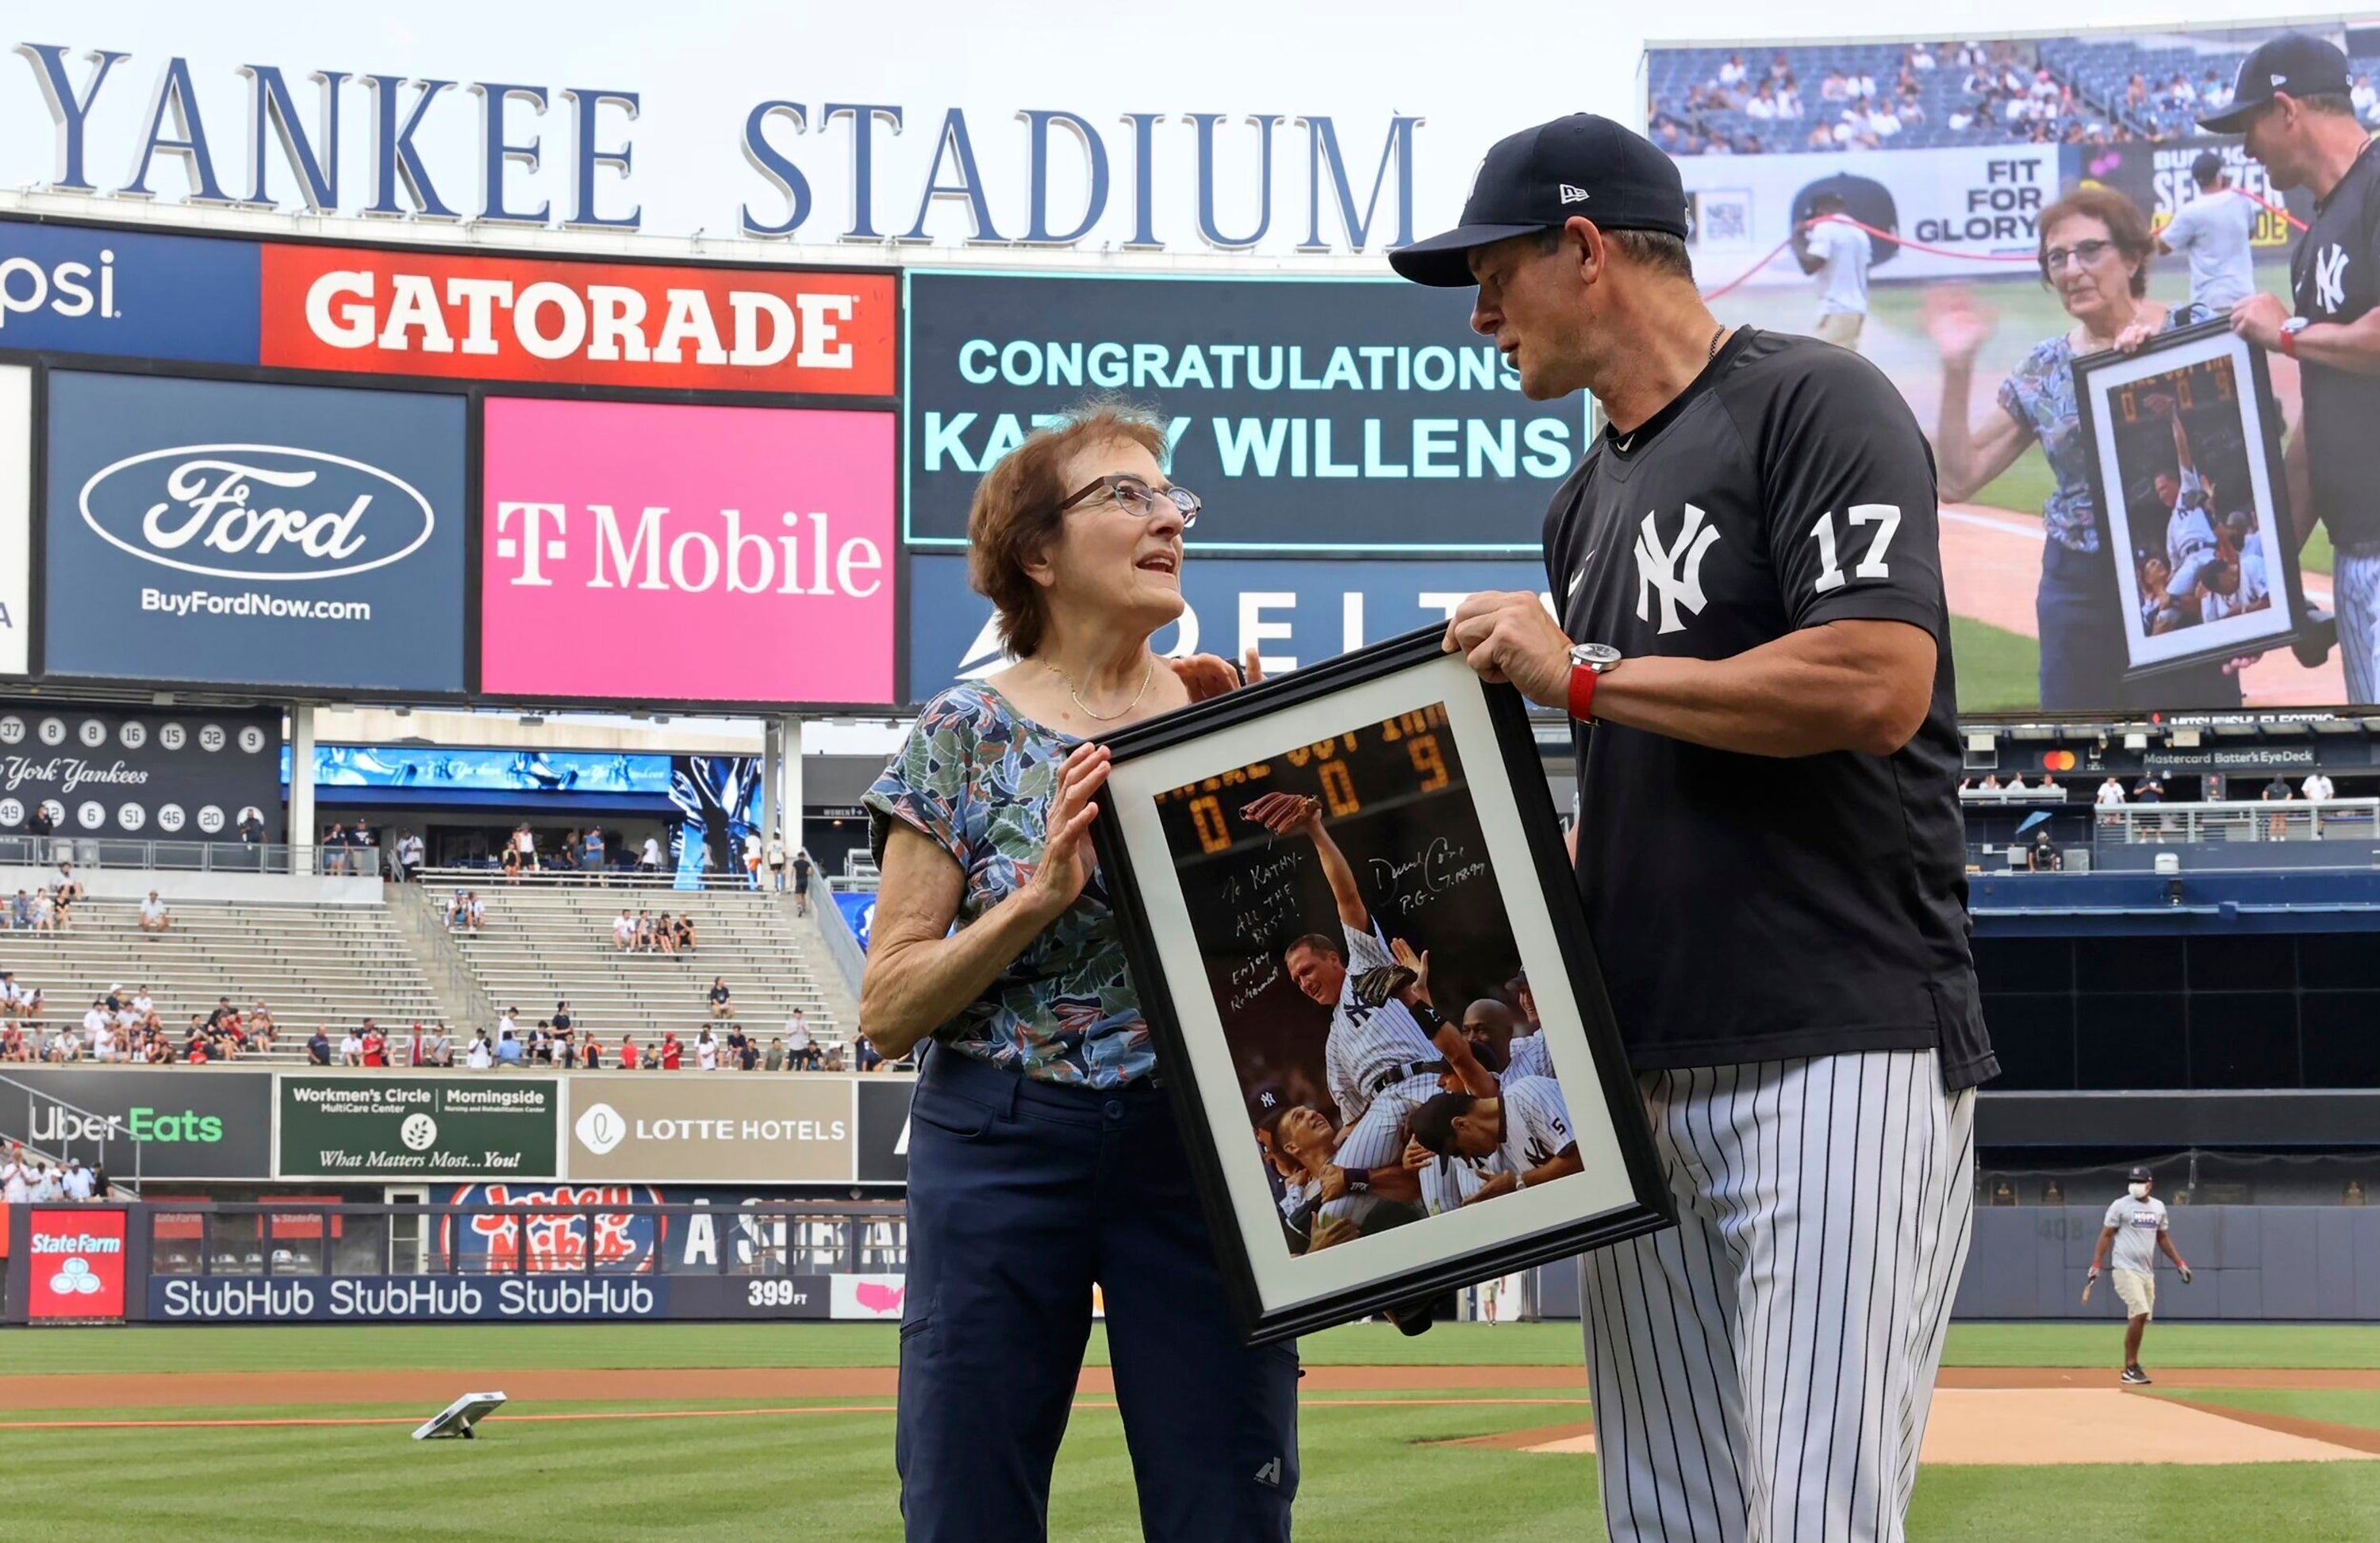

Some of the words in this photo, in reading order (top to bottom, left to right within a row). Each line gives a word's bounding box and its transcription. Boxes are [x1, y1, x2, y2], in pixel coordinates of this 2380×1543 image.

[12, 41, 642, 230] YANKEE
[739, 99, 1426, 252] STADIUM
[1987, 159, 2042, 183] FIT
[1967, 187, 2042, 213] FOR
[305, 269, 855, 370] GATORADE
[924, 412, 1192, 477] KAY
[1214, 416, 1572, 479] WILLENS
[143, 459, 374, 560] Ford
[585, 504, 882, 597] Mobile
[1810, 503, 1902, 594] 17
[1633, 502, 1722, 635] NY
[141, 588, 371, 620] BuyFordNow.com
[2, 723, 21, 737] 37
[48, 724, 57, 739] 8
[88, 726, 98, 739] 8
[125, 727, 141, 742] 16
[165, 729, 180, 743] 15
[203, 731, 221, 745] 32
[247, 732, 256, 747] 9
[2144, 753, 2211, 765] Mastercard
[2214, 751, 2259, 764] Batter's
[5, 755, 62, 792] York
[62, 758, 149, 793] Yankees
[1, 805, 20, 819] 49
[86, 808, 96, 822] 6
[125, 809, 140, 823] 51
[163, 811, 180, 824] 46
[202, 812, 220, 826] 20
[293, 1087, 382, 1103] Workmen's
[385, 1088, 432, 1104] Circle
[321, 1104, 370, 1113] MultiCare
[370, 1104, 405, 1114] Center
[446, 1088, 545, 1107] Morningside
[31, 1105, 122, 1142] Uber
[129, 1107, 223, 1143] Eats
[636, 1119, 735, 1141] LOTTE
[743, 1119, 846, 1141] HOTELS
[1551, 1116, 1567, 1136] 5
[319, 1150, 363, 1168] What
[365, 1150, 426, 1168] Matters
[164, 1279, 314, 1317] StubHub
[329, 1279, 482, 1316] StubHub
[498, 1280, 654, 1315] StubHub
